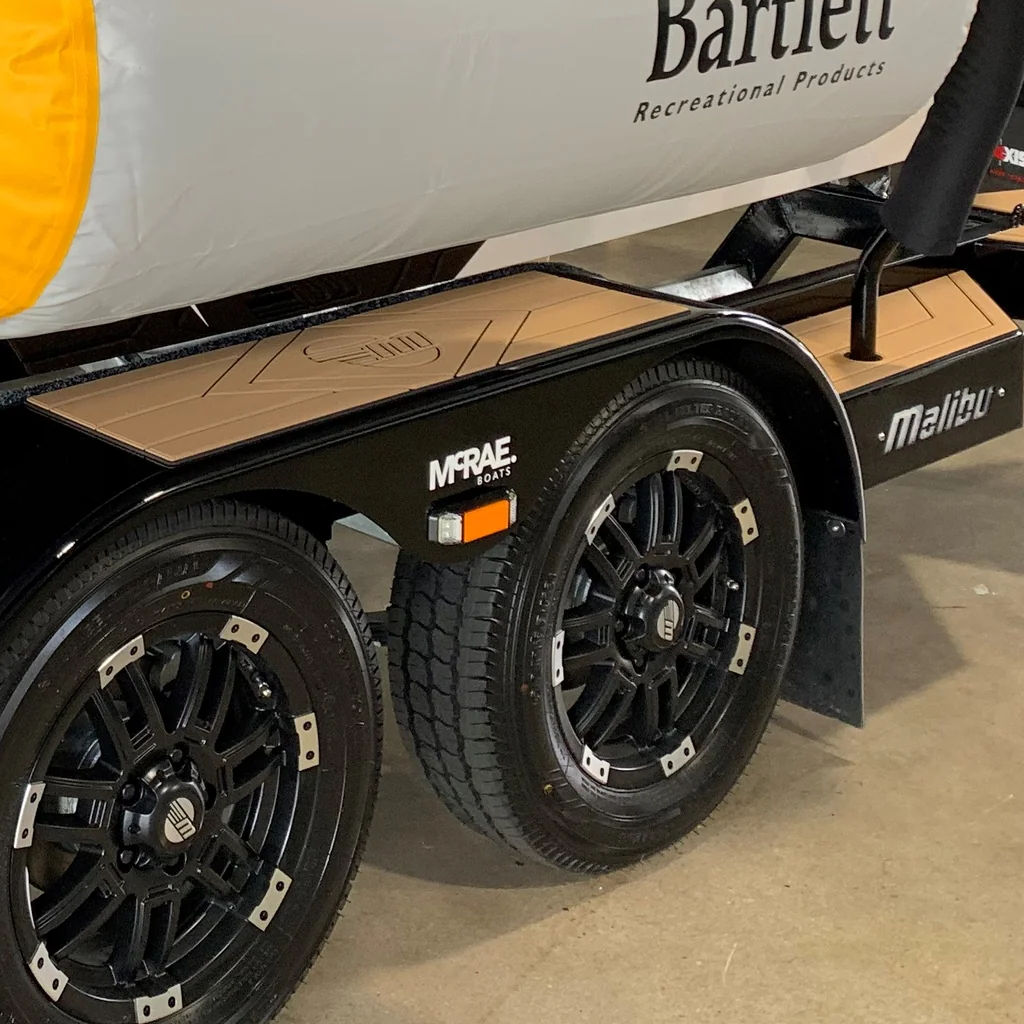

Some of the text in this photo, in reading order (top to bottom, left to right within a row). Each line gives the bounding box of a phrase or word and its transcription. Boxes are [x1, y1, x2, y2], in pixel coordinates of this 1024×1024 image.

[633, 59, 886, 124] Recreational Products
[884, 385, 994, 455] Malibu
[477, 466, 511, 486] BOATS
